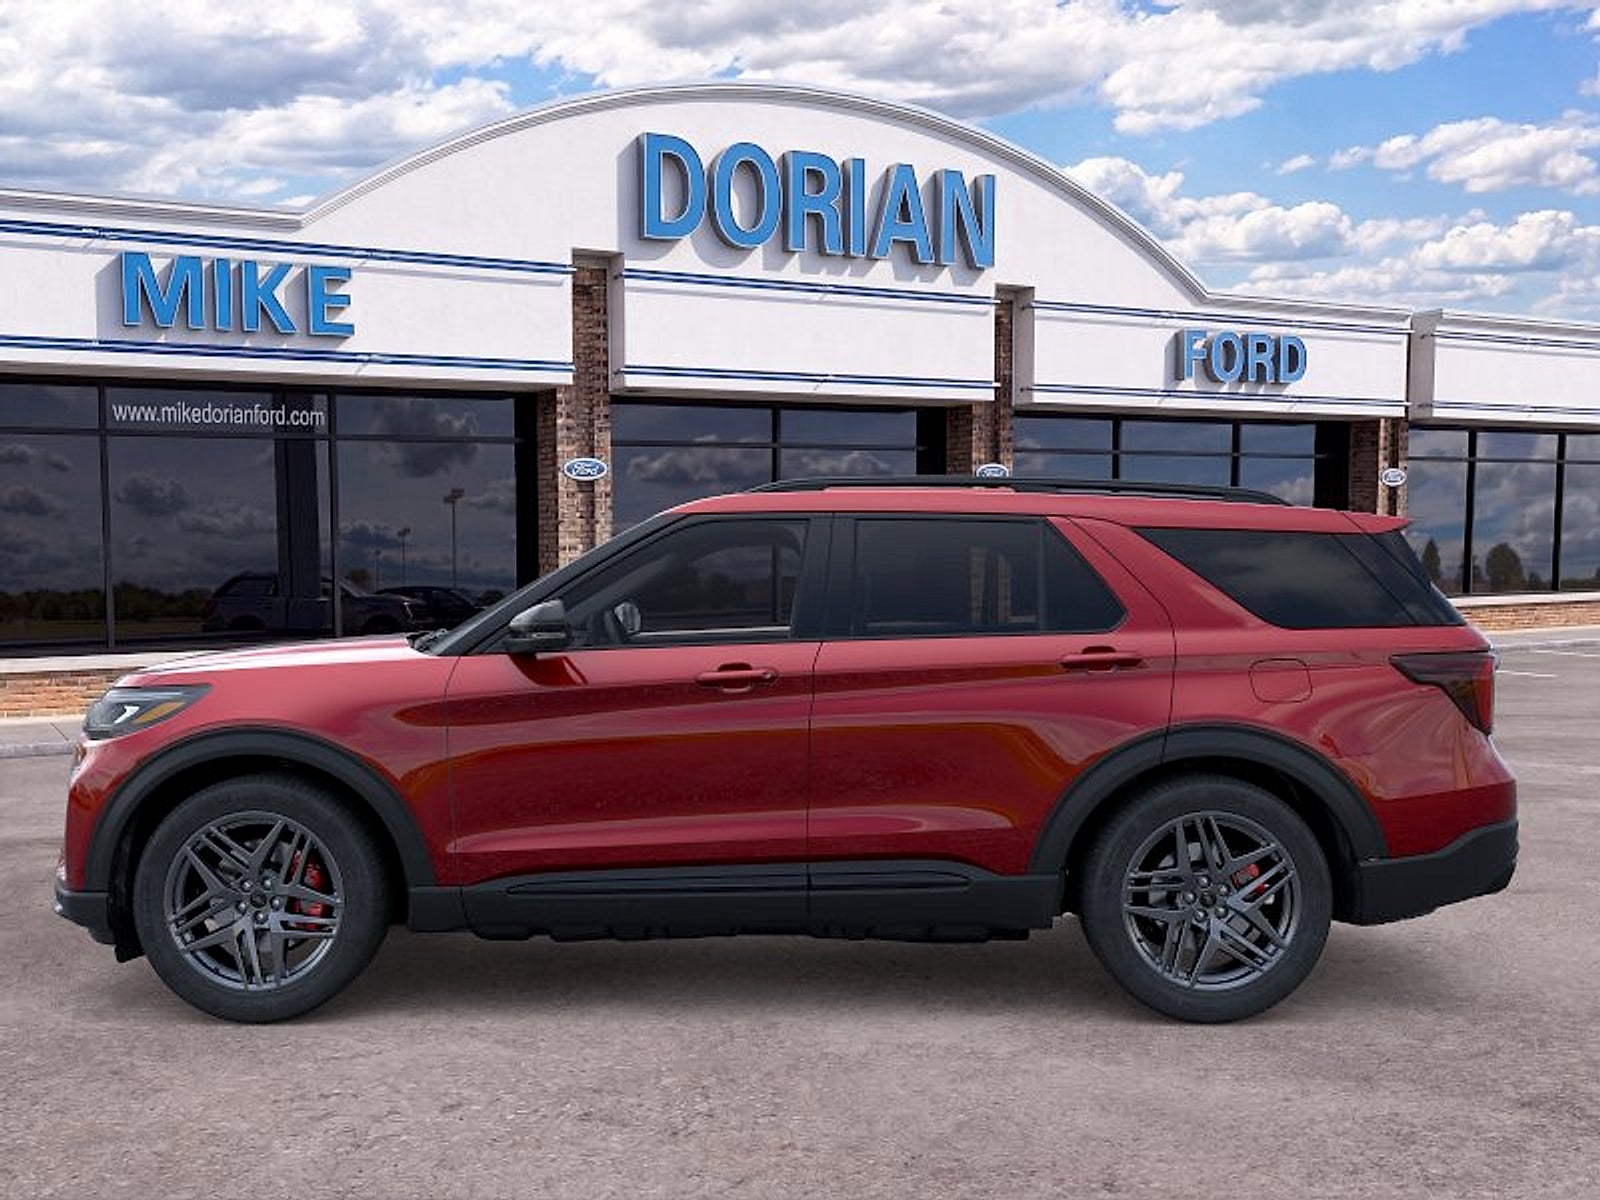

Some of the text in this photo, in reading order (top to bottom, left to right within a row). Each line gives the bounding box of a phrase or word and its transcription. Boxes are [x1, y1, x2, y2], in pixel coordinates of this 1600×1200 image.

[641, 132, 996, 270] DORIAN
[122, 252, 355, 336] MIKE
[1178, 328, 1308, 384] FORD
[112, 402, 325, 426] www.mikedorianford.com
